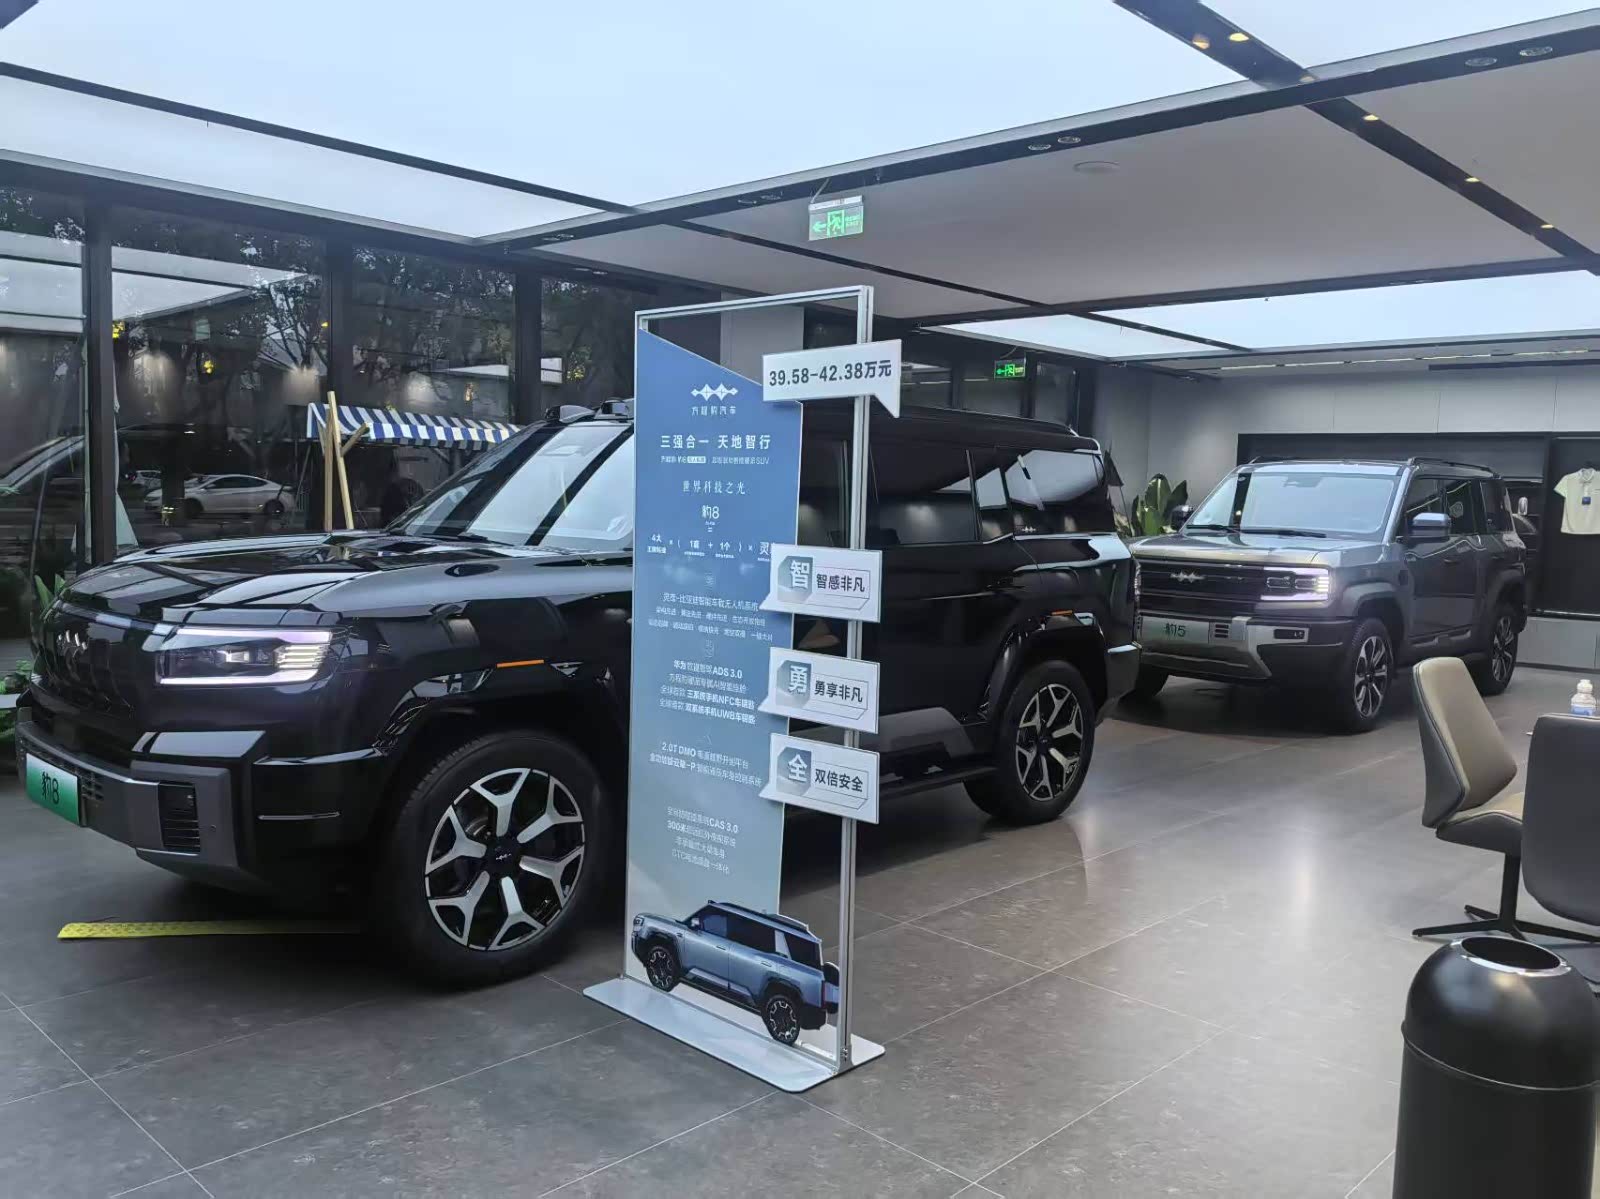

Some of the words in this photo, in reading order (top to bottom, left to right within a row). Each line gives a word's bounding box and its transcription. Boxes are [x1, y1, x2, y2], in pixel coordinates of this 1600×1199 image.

[769, 360, 891, 386] 39.58-42.38万元
[660, 434, 709, 449] 三强合一
[717, 434, 771, 450] 天地智行
[682, 480, 746, 494] 世界科技之光
[702, 505, 720, 519] 豹8
[790, 561, 810, 589] 智
[816, 574, 865, 592] 智感非凡
[730, 669, 743, 679] 3.0
[789, 665, 808, 694] 勇
[814, 680, 863, 703] 勇享非凡
[788, 754, 808, 783] 全
[41, 771, 60, 805] 豹8
[814, 768, 863, 793] 双倍安全
[726, 822, 739, 834] 3.0
